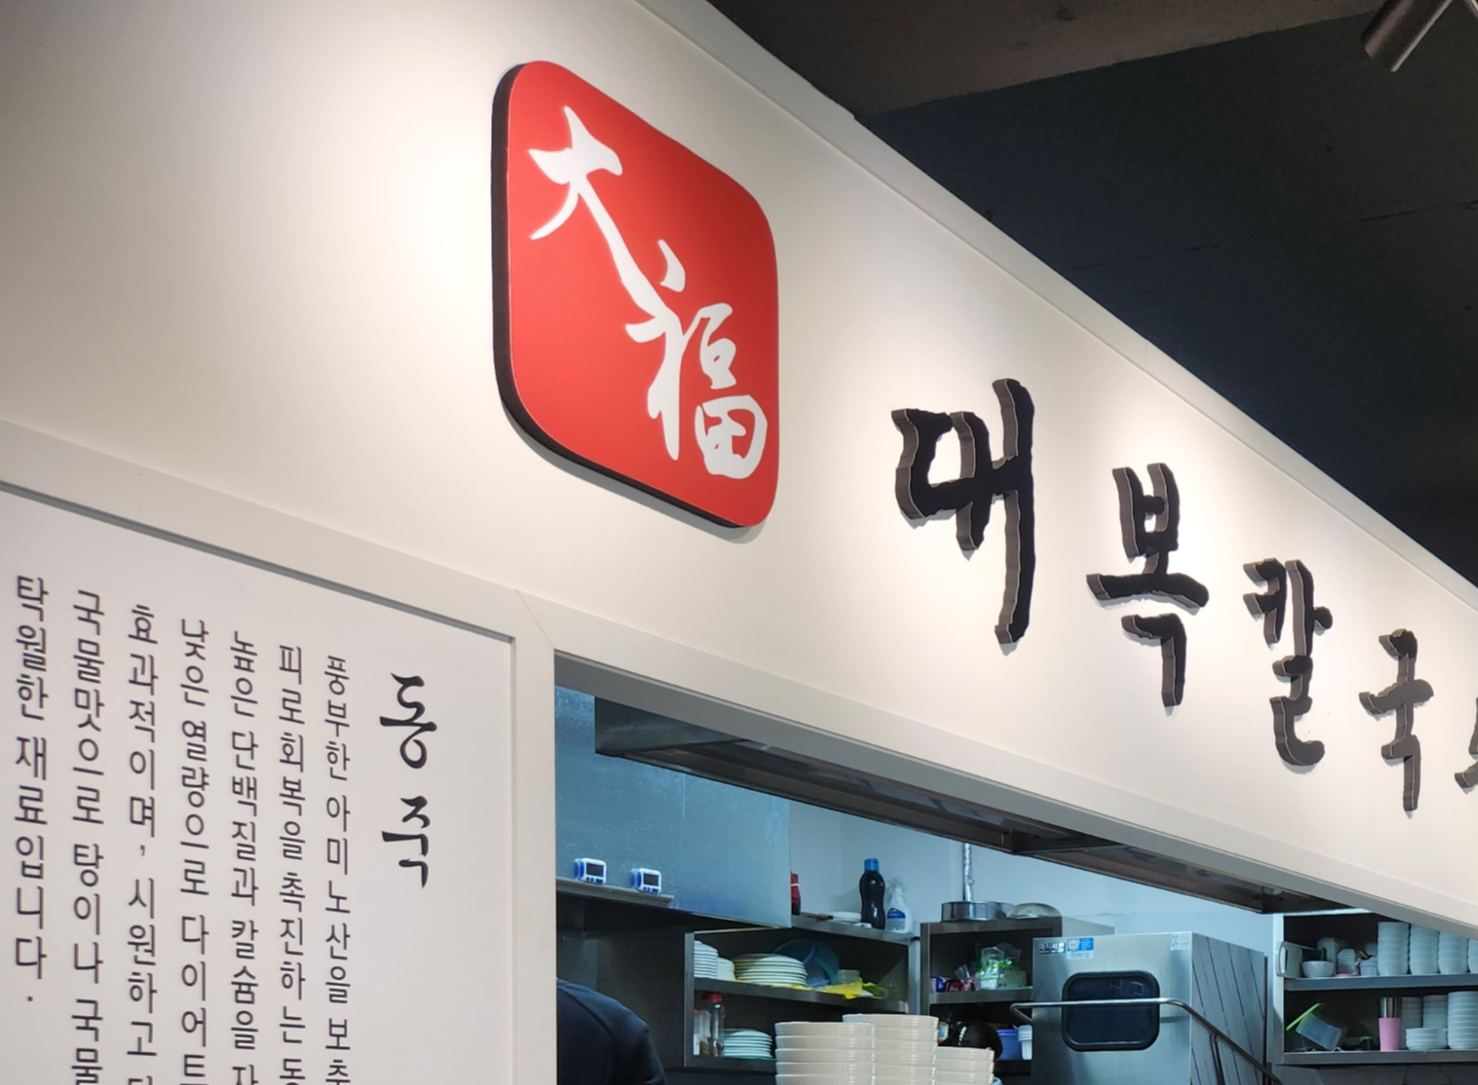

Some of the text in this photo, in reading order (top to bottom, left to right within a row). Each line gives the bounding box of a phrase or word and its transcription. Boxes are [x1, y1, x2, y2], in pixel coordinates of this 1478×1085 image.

[73, 589, 105, 825] 국물맛으로
[128, 604, 158, 857] 효과적이며,
[180, 618, 209, 707] 낮은
[230, 631, 258, 717] 높은
[325, 655, 350, 781] 풍부한
[15, 575, 49, 1001] 탁월한 재료입니다.
[180, 720, 210, 896] 열량으로
[230, 731, 259, 906] 단백질과
[279, 645, 305, 861] 피로회복을
[380, 673, 437, 889] 동죽
[73, 843, 104, 984] 탕이나
[127, 877, 158, 1056] 시원하고
[231, 920, 259, 1050] 칼슘을
[279, 872, 306, 1043] 촉진하는
[325, 795, 351, 1004] 아미노산을
